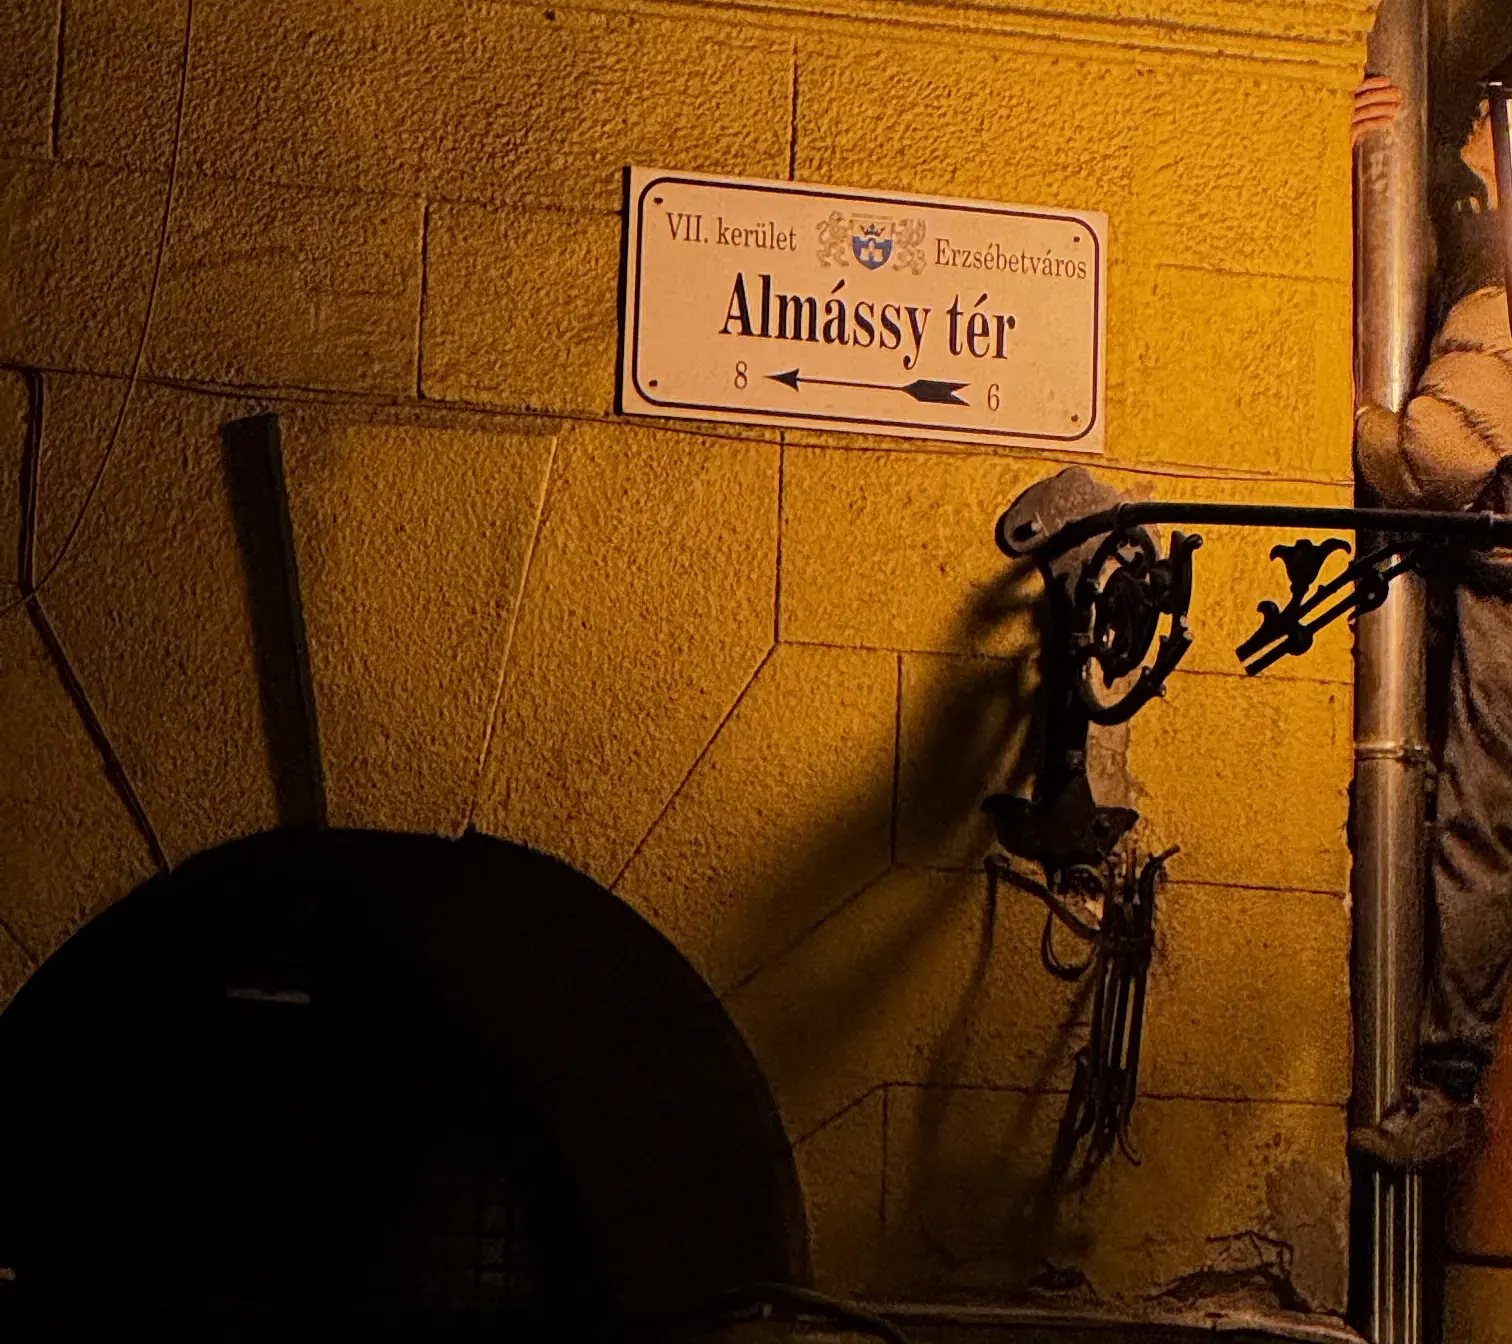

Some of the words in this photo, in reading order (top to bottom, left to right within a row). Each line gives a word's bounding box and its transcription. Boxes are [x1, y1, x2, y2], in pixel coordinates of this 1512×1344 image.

[667, 212, 708, 244] VII.
[716, 216, 797, 252] kerület
[935, 238, 1087, 279] Erzsébetváros
[718, 272, 930, 370] Almássy
[946, 293, 1015, 360] tér
[735, 361, 748, 390] 8
[987, 384, 1000, 411] 6
